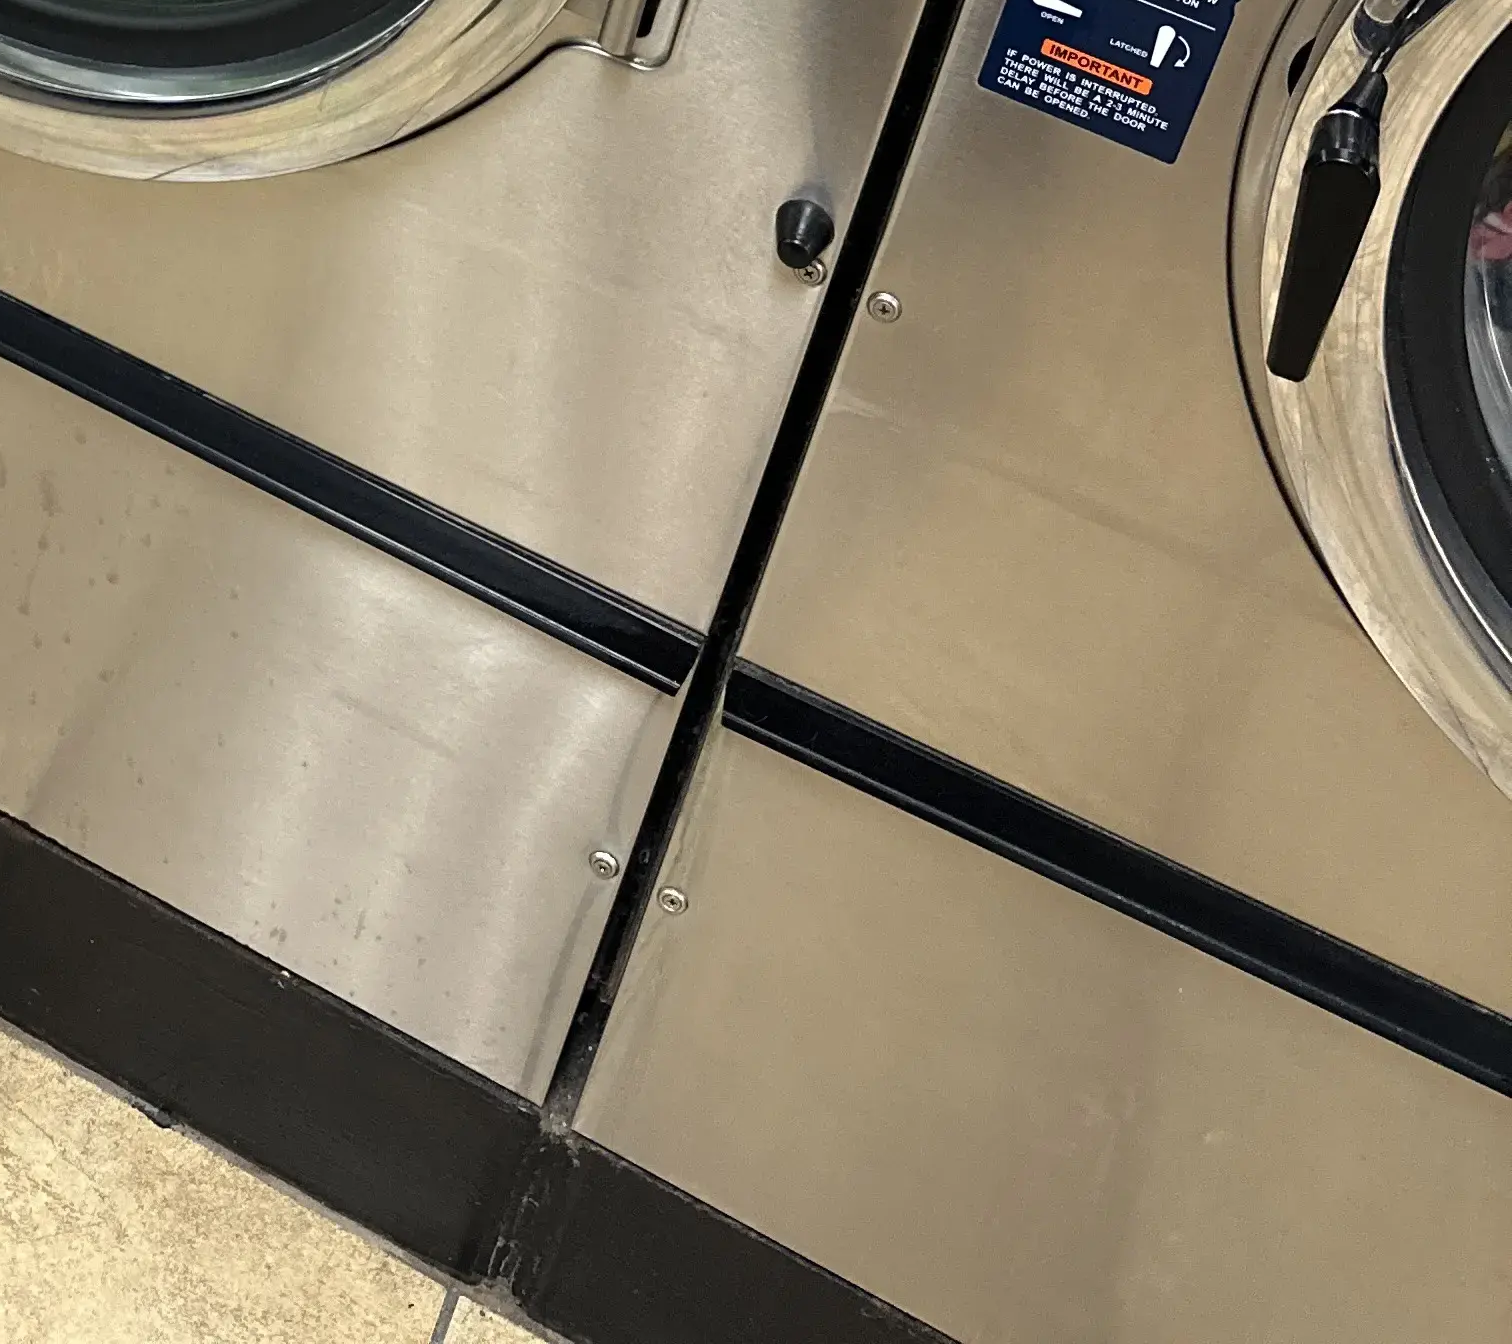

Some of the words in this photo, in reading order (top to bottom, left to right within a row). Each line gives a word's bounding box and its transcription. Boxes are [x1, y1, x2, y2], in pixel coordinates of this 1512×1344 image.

[1040, 11, 1064, 24] OPEN
[1109, 38, 1148, 57] LATCHED
[1006, 48, 1017, 57] IF
[1021, 54, 1061, 76] POWER
[1065, 71, 1076, 82] IS
[1049, 44, 1143, 88] IMPORTANT
[997, 76, 1020, 90] CAN
[1024, 86, 1039, 98] BE
[1000, 66, 1035, 85] DELAY
[1038, 82, 1082, 105] BEFORE
[1088, 101, 1109, 116] THE
[1113, 112, 1146, 131] DOOR
[1004, 57, 1039, 77] THERE
[1044, 73, 1068, 90] WILL
[1073, 86, 1089, 97] BE
[1092, 94, 1101, 103] A
[1105, 99, 1122, 111] 2-3
[1126, 107, 1168, 130] MINUTE
